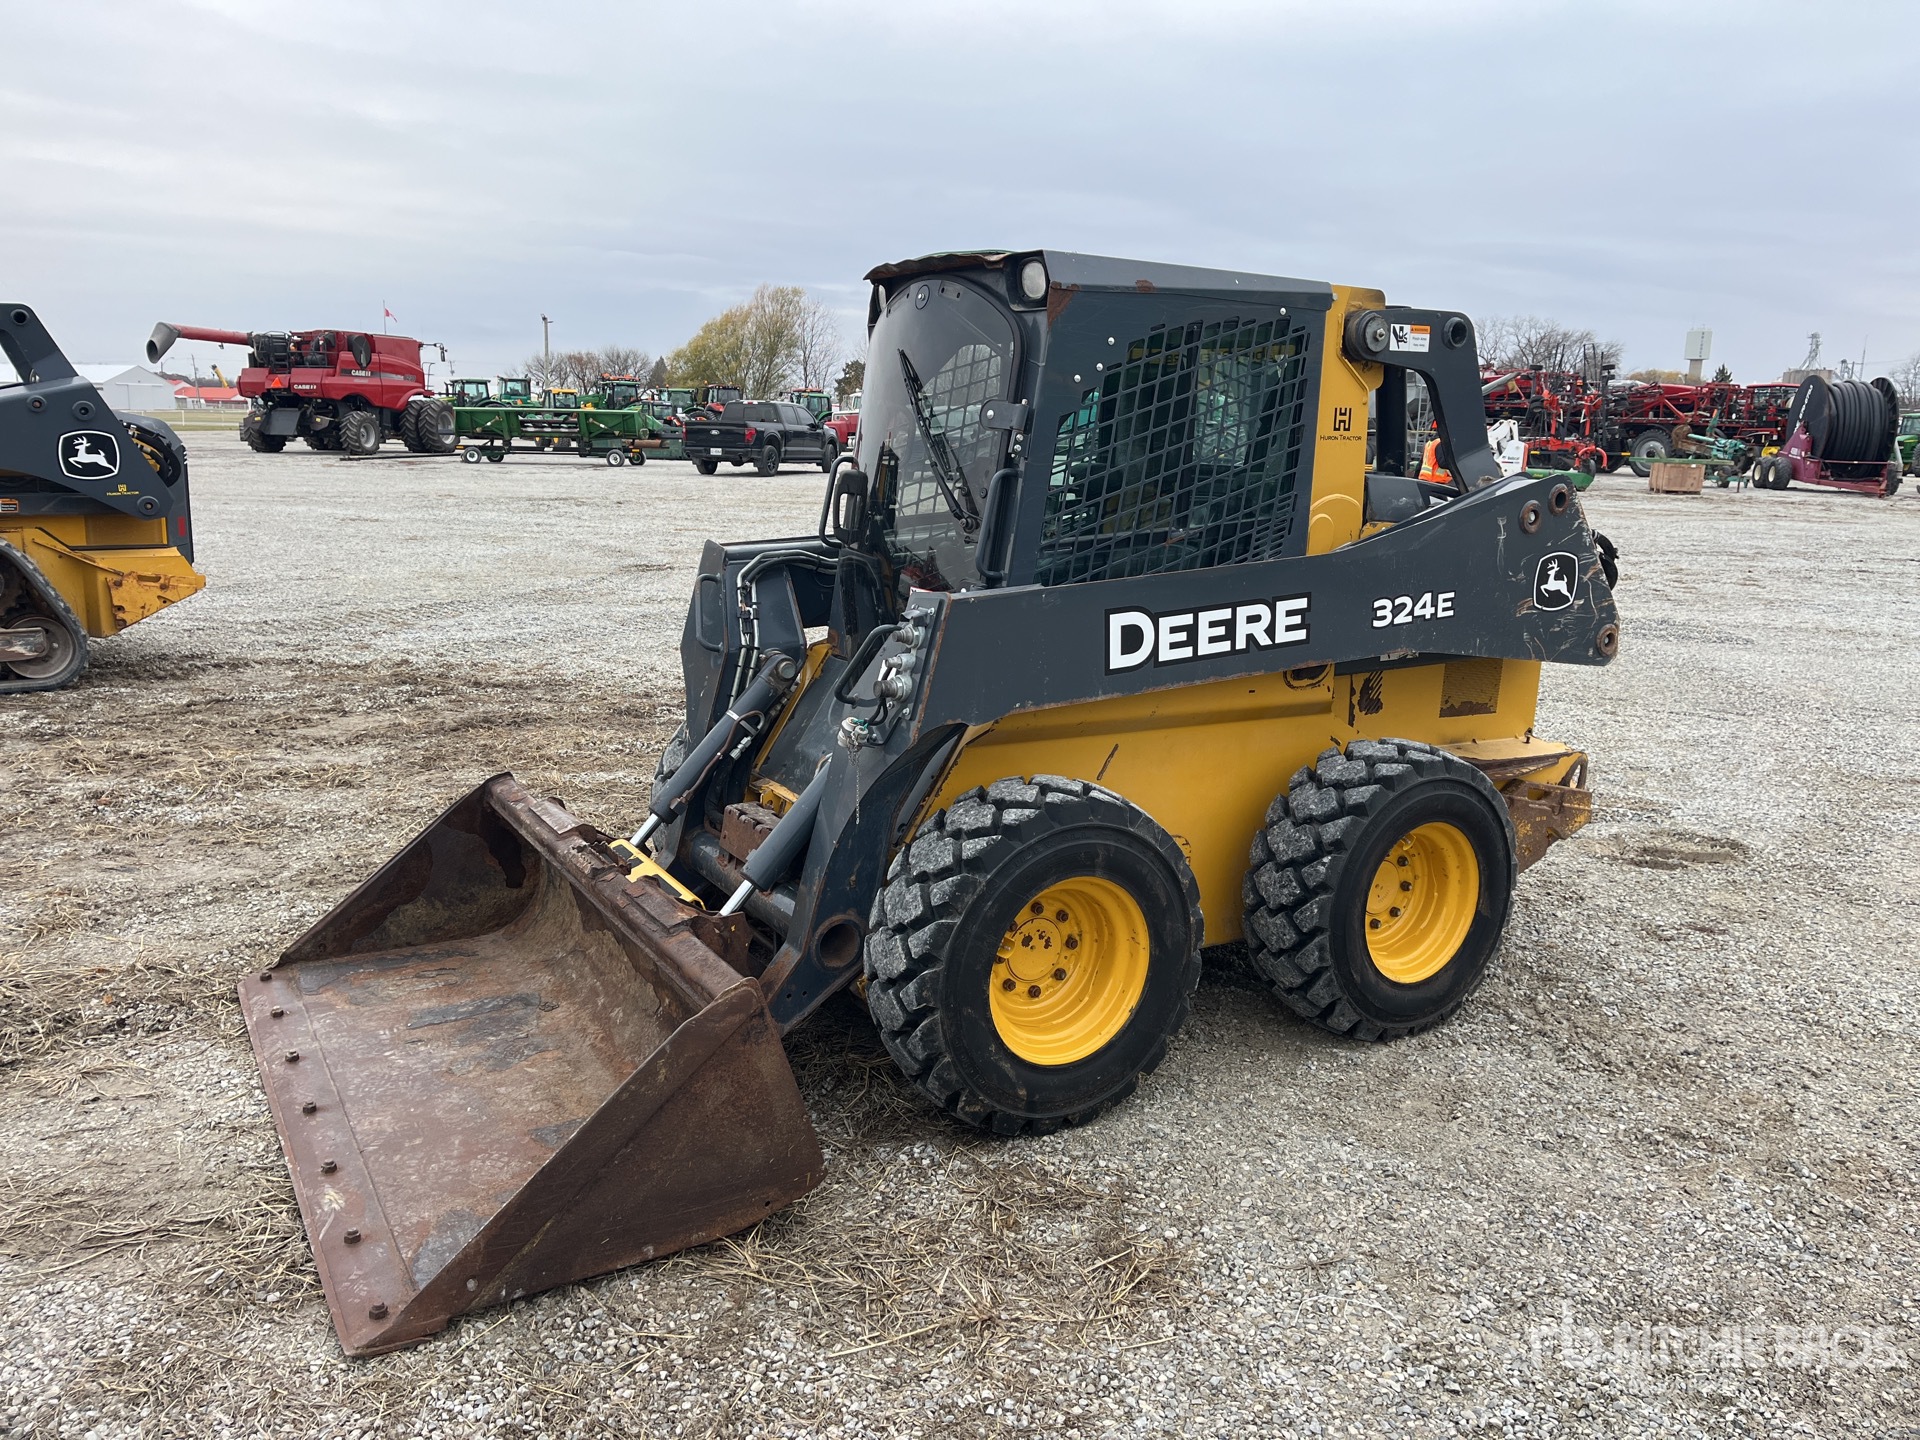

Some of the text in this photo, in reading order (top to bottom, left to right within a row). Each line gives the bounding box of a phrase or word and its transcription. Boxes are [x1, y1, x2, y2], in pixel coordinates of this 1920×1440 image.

[351, 369, 366, 377] CASE
[1109, 591, 1455, 670] DEERE 324E
